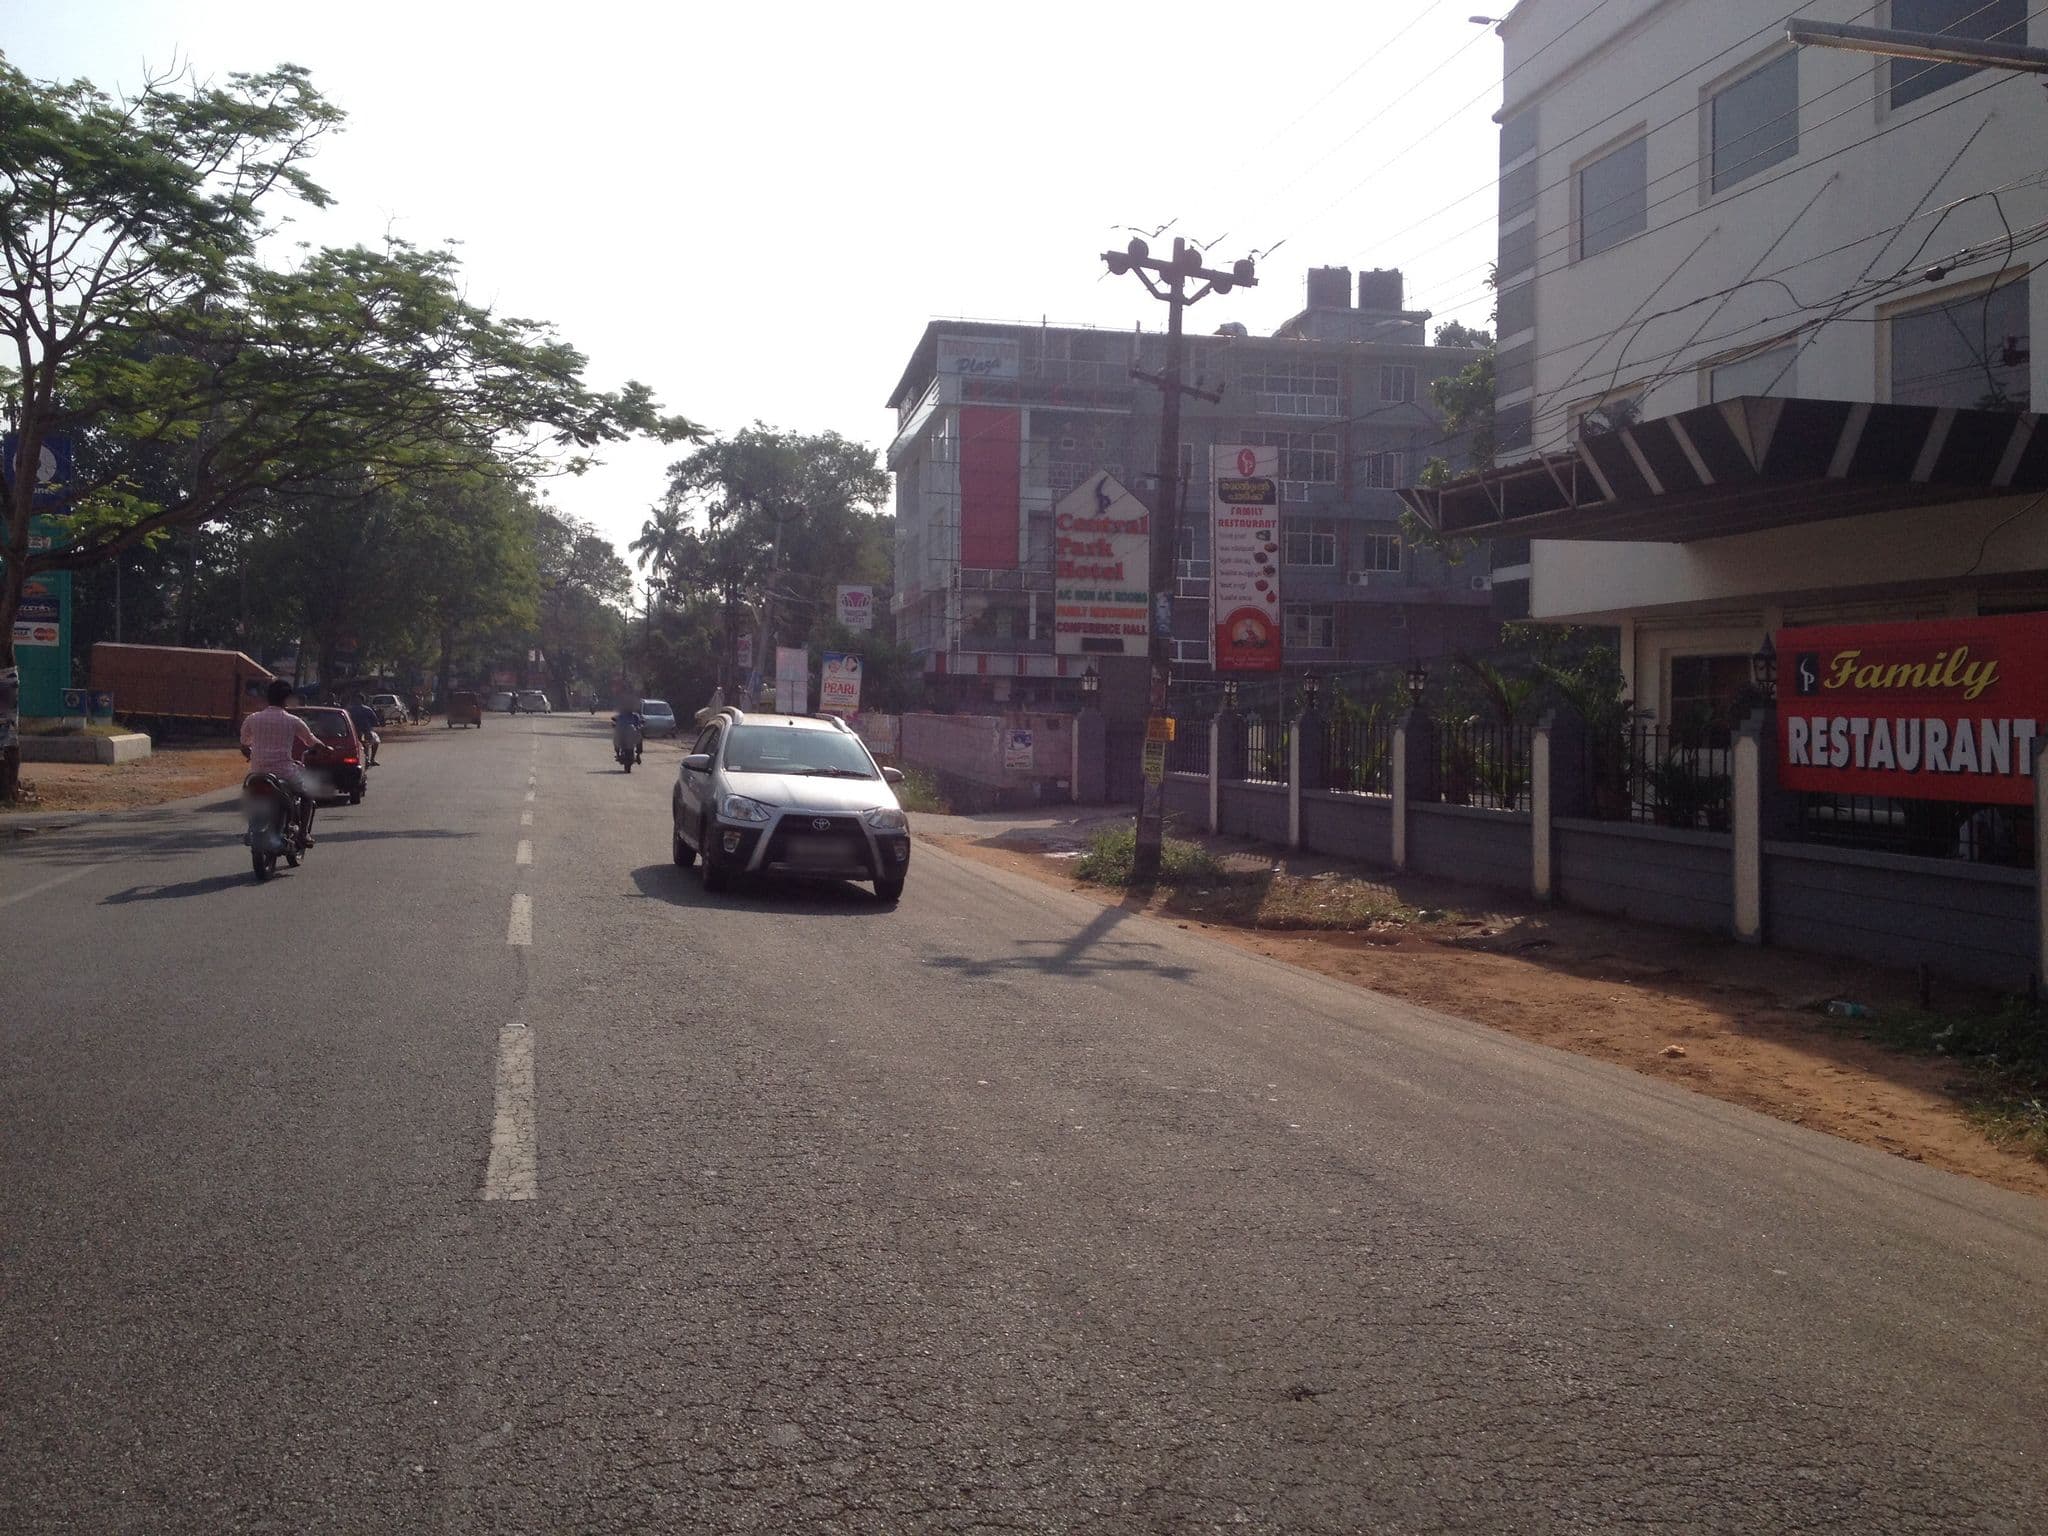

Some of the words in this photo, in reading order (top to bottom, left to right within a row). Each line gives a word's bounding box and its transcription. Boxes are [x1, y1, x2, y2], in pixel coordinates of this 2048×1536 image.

[1231, 507, 1264, 516] FAMILY
[1056, 513, 1149, 535] Central
[1218, 519, 1277, 528] RESTAURANT
[1056, 537, 1114, 557] Park
[1056, 560, 1124, 580] Hotel
[1114, 591, 1148, 603] ROOMS
[1057, 622, 1120, 634] CONFERENCE
[1123, 623, 1147, 635] HALL
[1824, 645, 1999, 701] Family
[824, 682, 857, 695] PEARL
[1788, 716, 2037, 776] RESTAURANT
